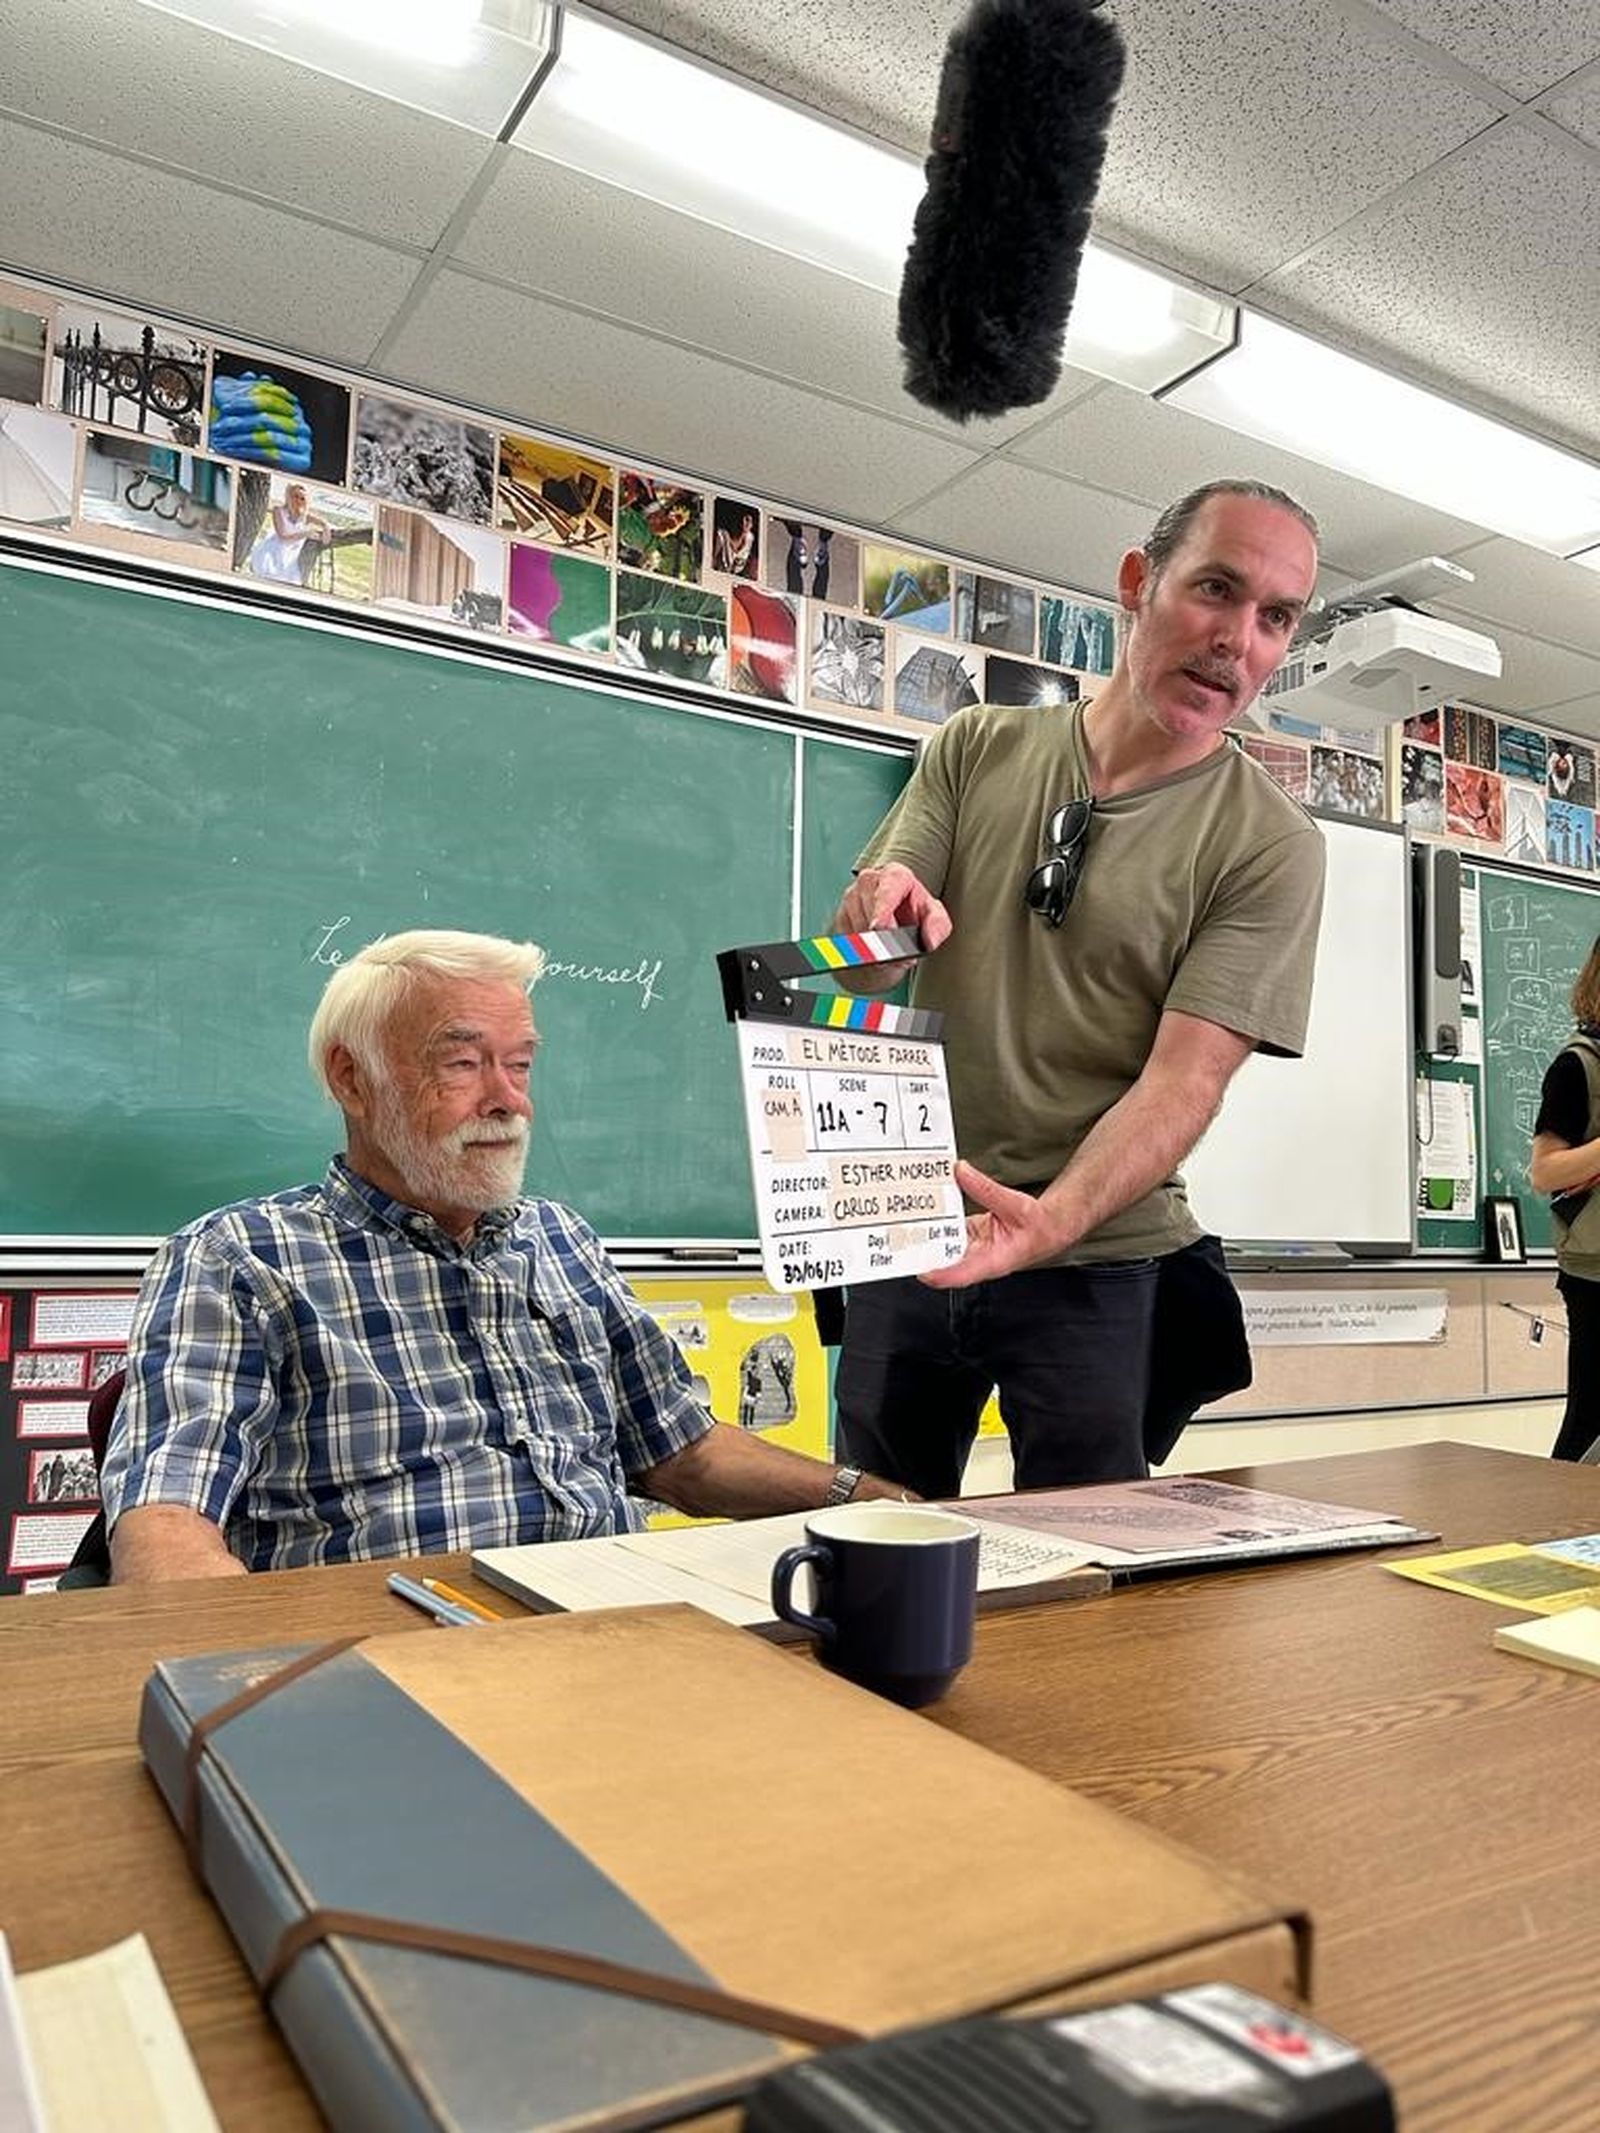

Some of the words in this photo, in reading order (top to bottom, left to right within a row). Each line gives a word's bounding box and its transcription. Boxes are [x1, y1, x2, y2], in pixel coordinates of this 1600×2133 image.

[752, 1046, 786, 1062] PROD.
[802, 1039, 823, 1061] EL
[889, 1047, 931, 1066] FARRER
[768, 1076, 796, 1089] ROLL
[839, 1079, 868, 1092] SCENE
[817, 1101, 850, 1133] 11A
[874, 1101, 888, 1134] 7
[919, 1104, 932, 1132] 2
[772, 1177, 831, 1193] DIRECTOR:
[841, 1164, 896, 1186] ESTHER
[899, 1160, 951, 1181] MORENTE
[774, 1209, 826, 1223] CAMERA:
[834, 1197, 881, 1220] CARLOS
[887, 1195, 936, 1214] APARICIO
[778, 1241, 812, 1258] DATE:
[870, 1255, 893, 1267] Filter
[783, 1259, 844, 1285] 30/06/23
